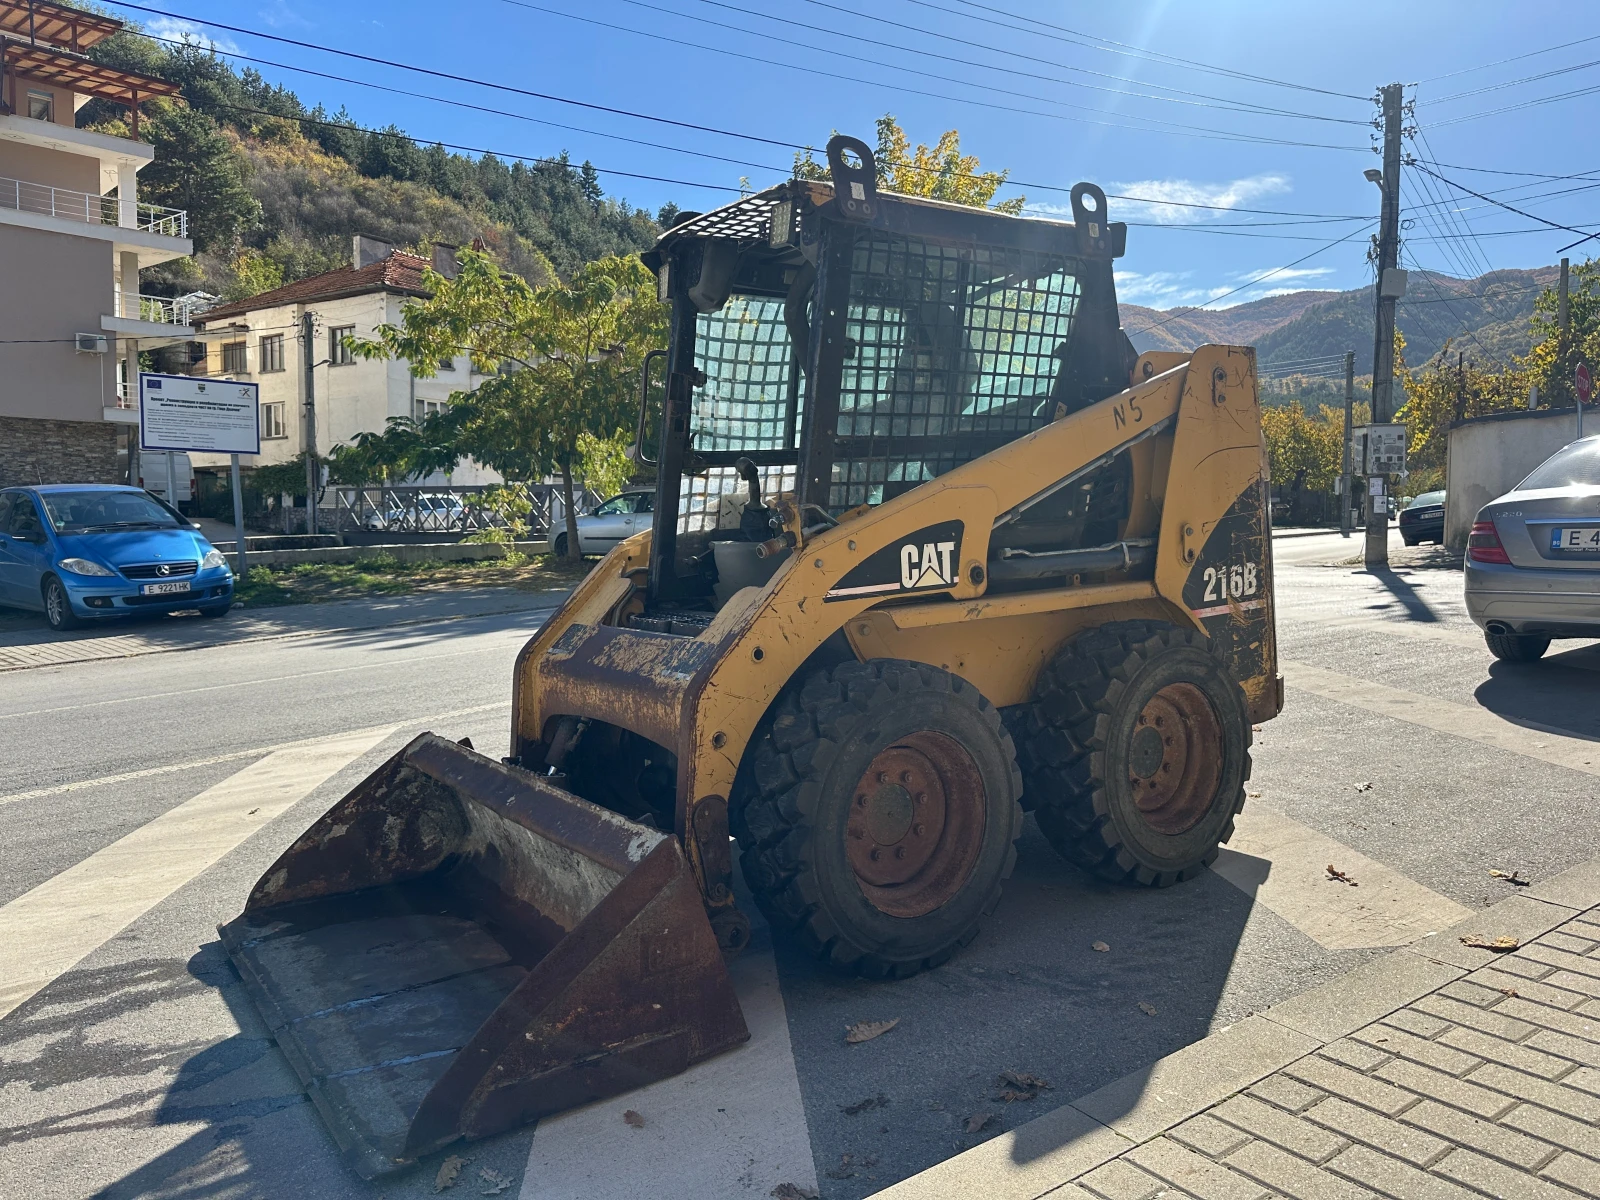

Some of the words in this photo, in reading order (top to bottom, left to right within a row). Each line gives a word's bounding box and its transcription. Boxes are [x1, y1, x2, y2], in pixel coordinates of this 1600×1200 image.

[1129, 395, 1143, 423] 5
[900, 541, 956, 589] CAT
[1203, 562, 1257, 602] 216B
[148, 585, 154, 593] E
